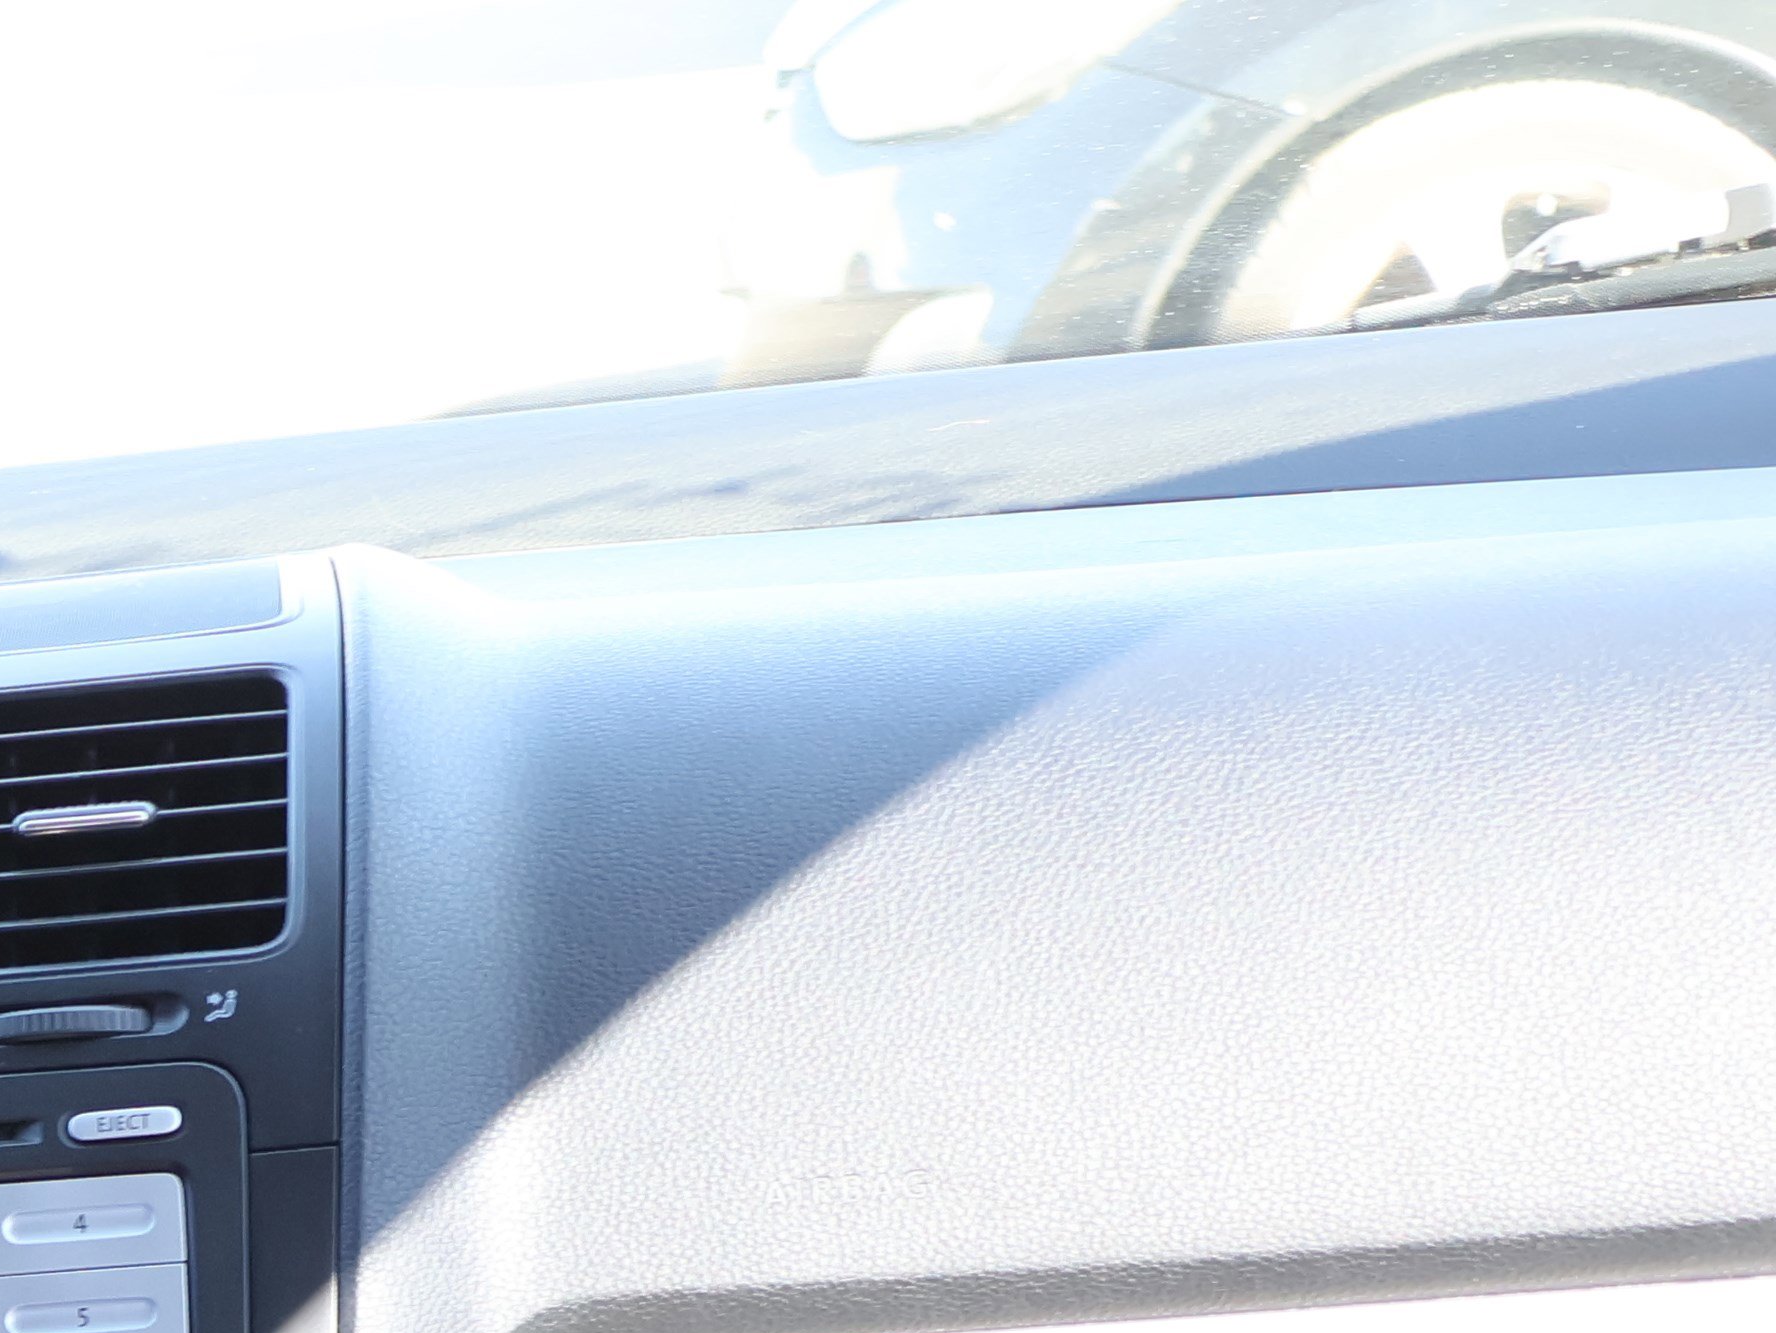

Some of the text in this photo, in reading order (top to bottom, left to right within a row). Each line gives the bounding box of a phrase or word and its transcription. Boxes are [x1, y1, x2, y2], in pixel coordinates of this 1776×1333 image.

[96, 1112, 151, 1134] EJECT
[72, 1214, 88, 1234] 4
[77, 1308, 89, 1327] 5
